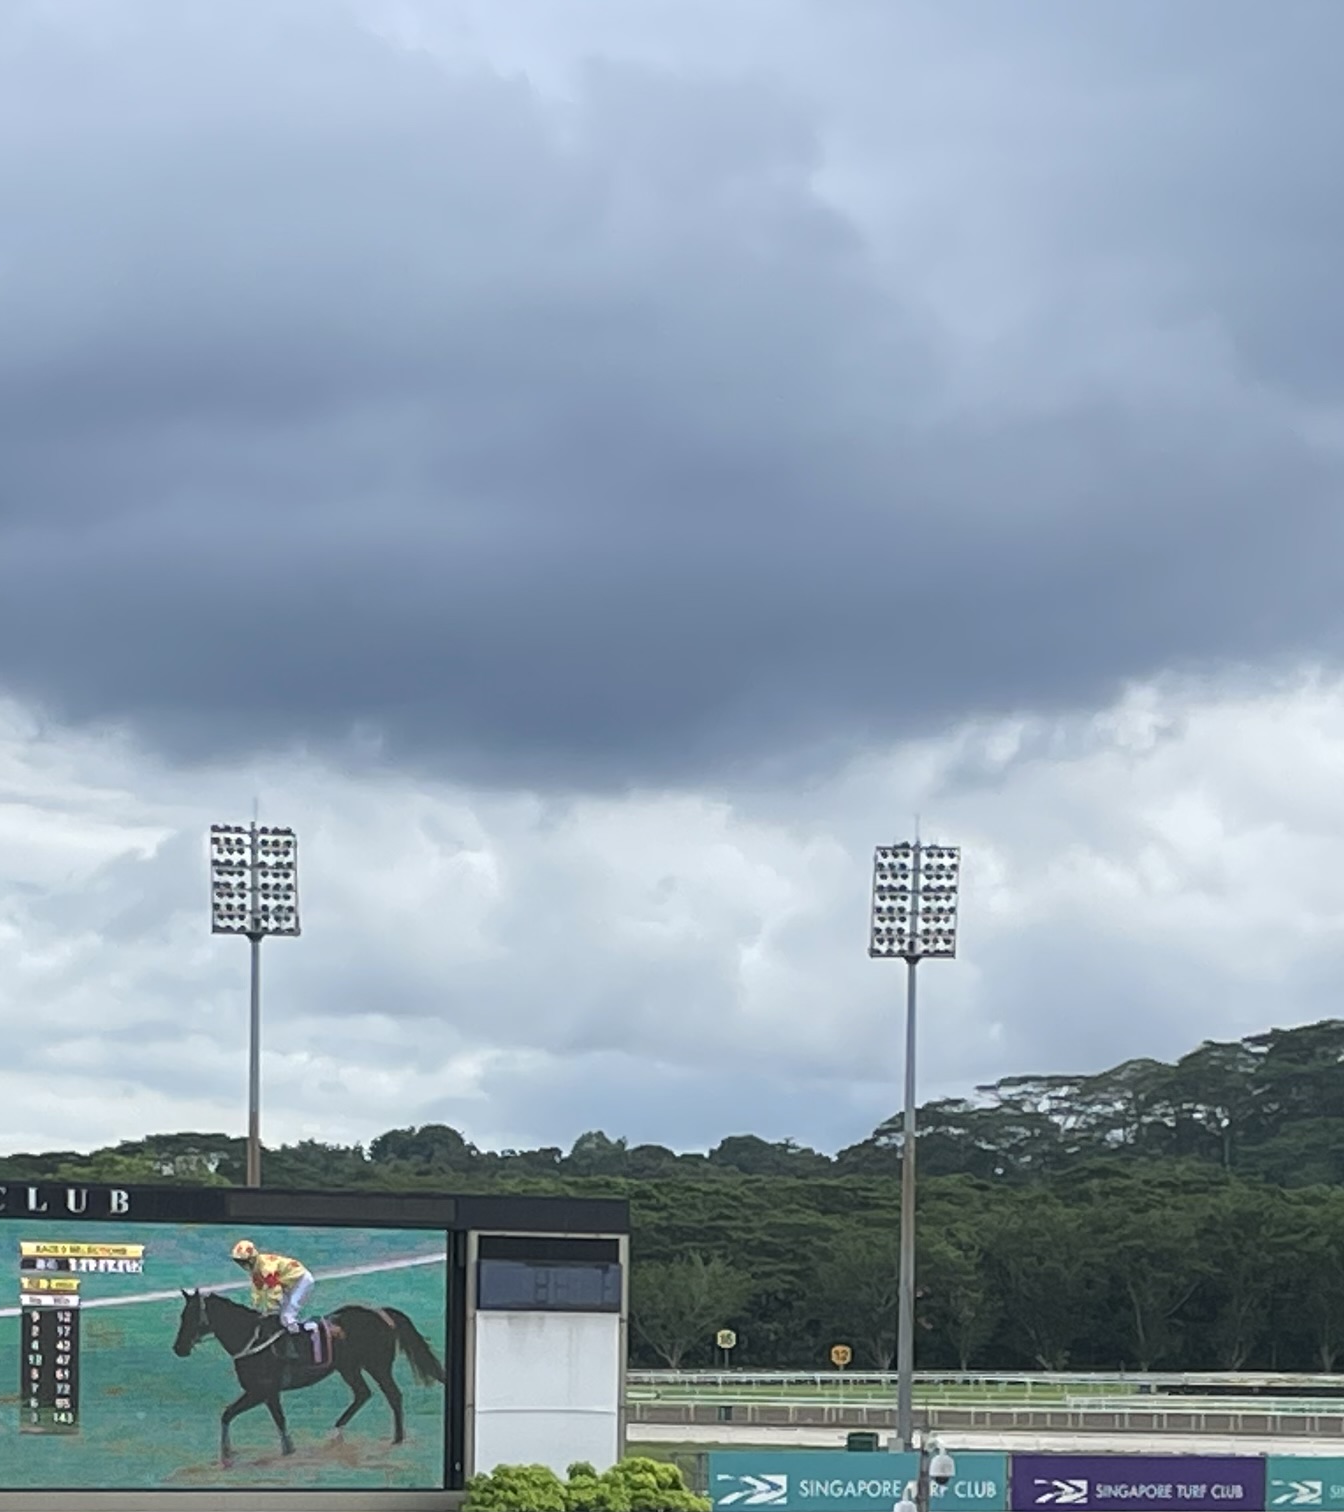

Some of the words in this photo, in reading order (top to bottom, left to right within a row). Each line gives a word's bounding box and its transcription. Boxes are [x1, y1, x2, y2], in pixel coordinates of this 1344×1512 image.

[799, 1480, 902, 1498] SINGAPORE
[955, 1481, 997, 1498] CLUB
[1095, 1483, 1173, 1499] SINGAPORE
[1176, 1483, 1206, 1499] TURF
[1210, 1484, 1244, 1499] CLUB
